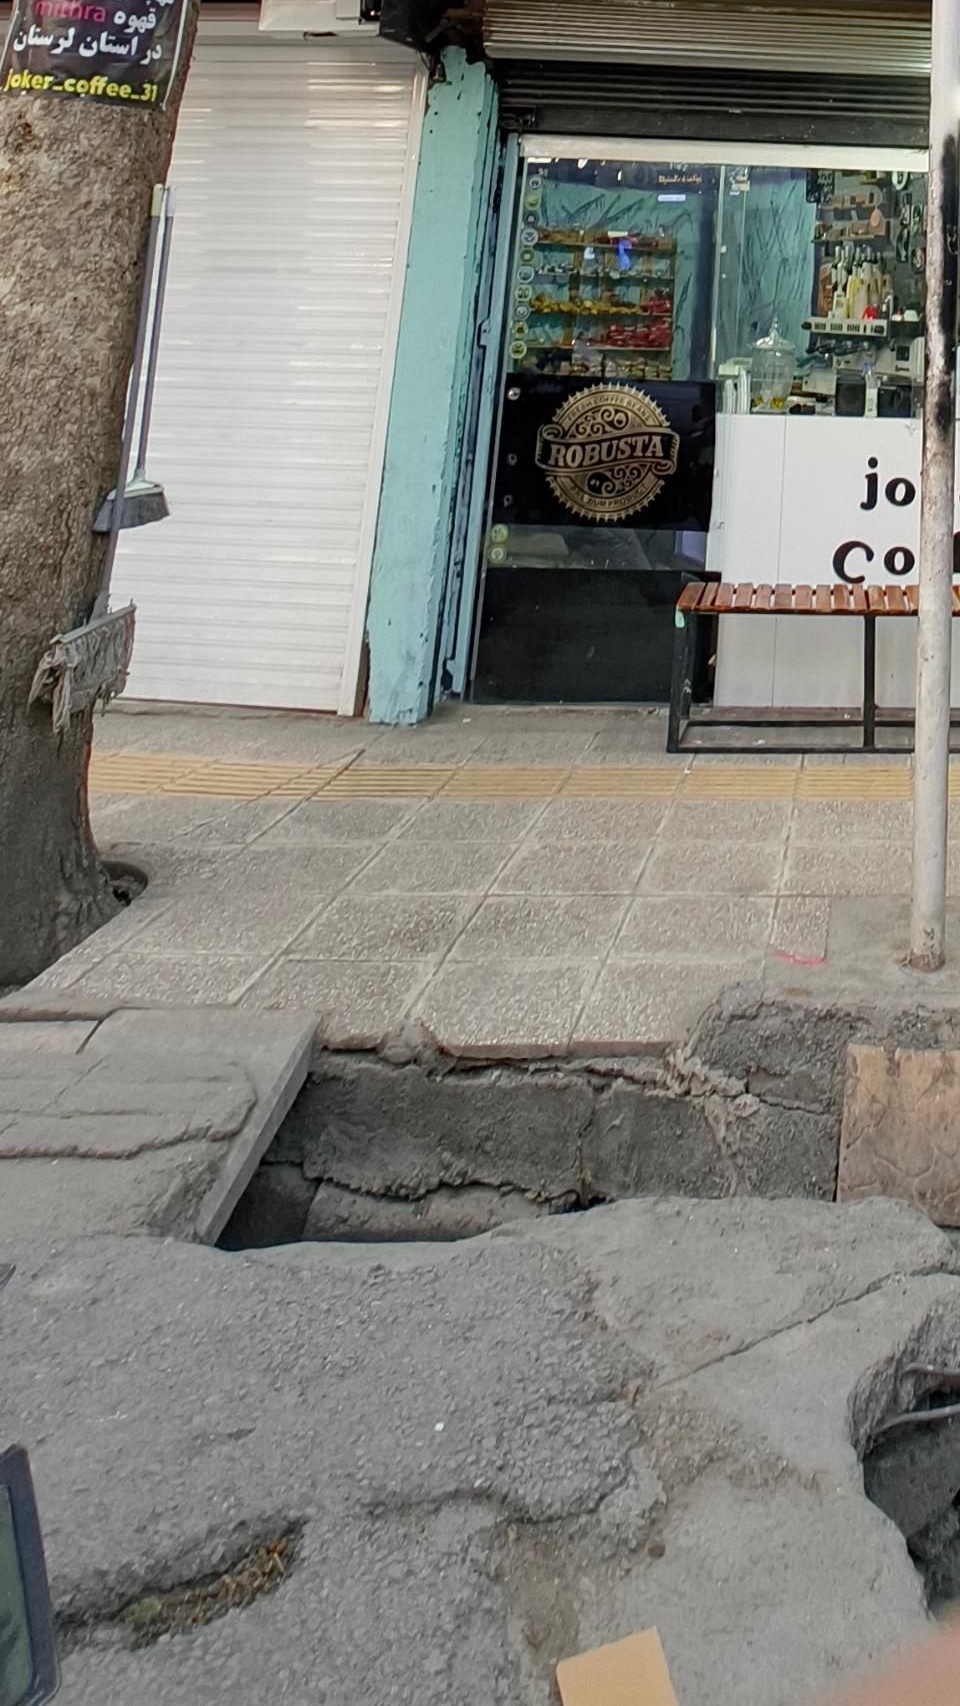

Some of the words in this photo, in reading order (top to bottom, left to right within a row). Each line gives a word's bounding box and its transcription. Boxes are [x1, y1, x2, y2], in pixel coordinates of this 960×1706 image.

[113, 7, 157, 34] قهوه
[13, 24, 76, 55] لرستان
[78, 30, 139, 57] استان
[139, 44, 163, 65] در
[4, 68, 158, 102] joker_coffee_31
[548, 436, 664, 467] ROBUSTA
